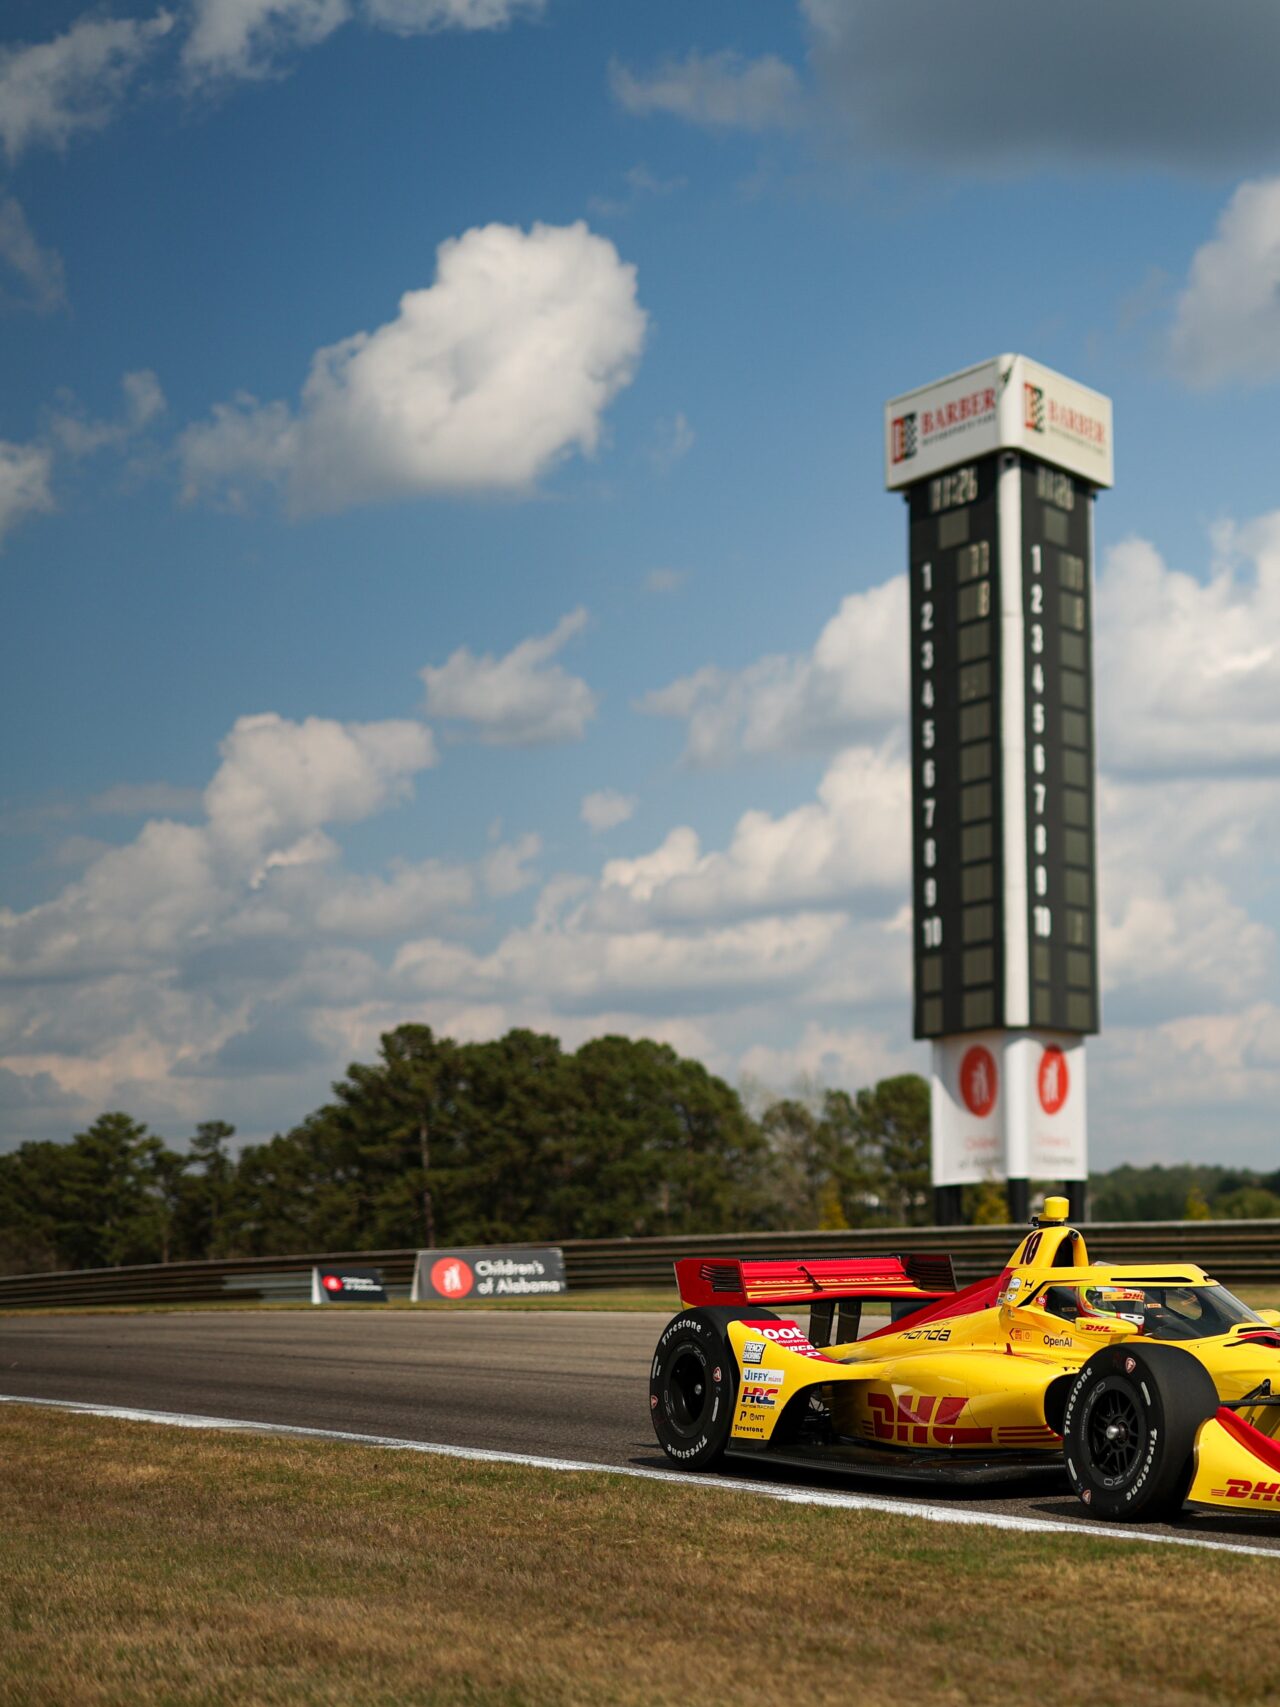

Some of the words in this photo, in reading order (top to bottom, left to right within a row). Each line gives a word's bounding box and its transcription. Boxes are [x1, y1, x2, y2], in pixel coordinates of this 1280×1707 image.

[922, 388, 996, 434] BARBER
[1031, 544, 1042, 574] 1
[922, 561, 932, 591] 1
[1031, 584, 1043, 614] 2
[921, 601, 933, 631] 2
[1031, 624, 1043, 653] 3
[922, 641, 933, 670] 3
[922, 679, 934, 709] 4
[1033, 702, 1044, 734] 5
[923, 719, 935, 749] 5
[923, 798, 936, 829] 7
[1033, 783, 1046, 814] 7
[922, 916, 942, 948] 10
[1033, 905, 1051, 938] 10
[1019, 1231, 1044, 1265] 10
[475, 1259, 544, 1276] Children's
[477, 1277, 494, 1294] of
[496, 1277, 560, 1294] Alabama
[1122, 1292, 1144, 1300] DHL
[661, 1319, 702, 1346] Firestone
[1043, 1335, 1073, 1348] OpenAI
[1085, 1324, 1111, 1332] DHL
[1064, 1367, 1092, 1435] Firestone
[867, 1392, 992, 1445] DHL
[667, 1435, 708, 1459] Firestone
[1126, 1428, 1157, 1500] Firestone
